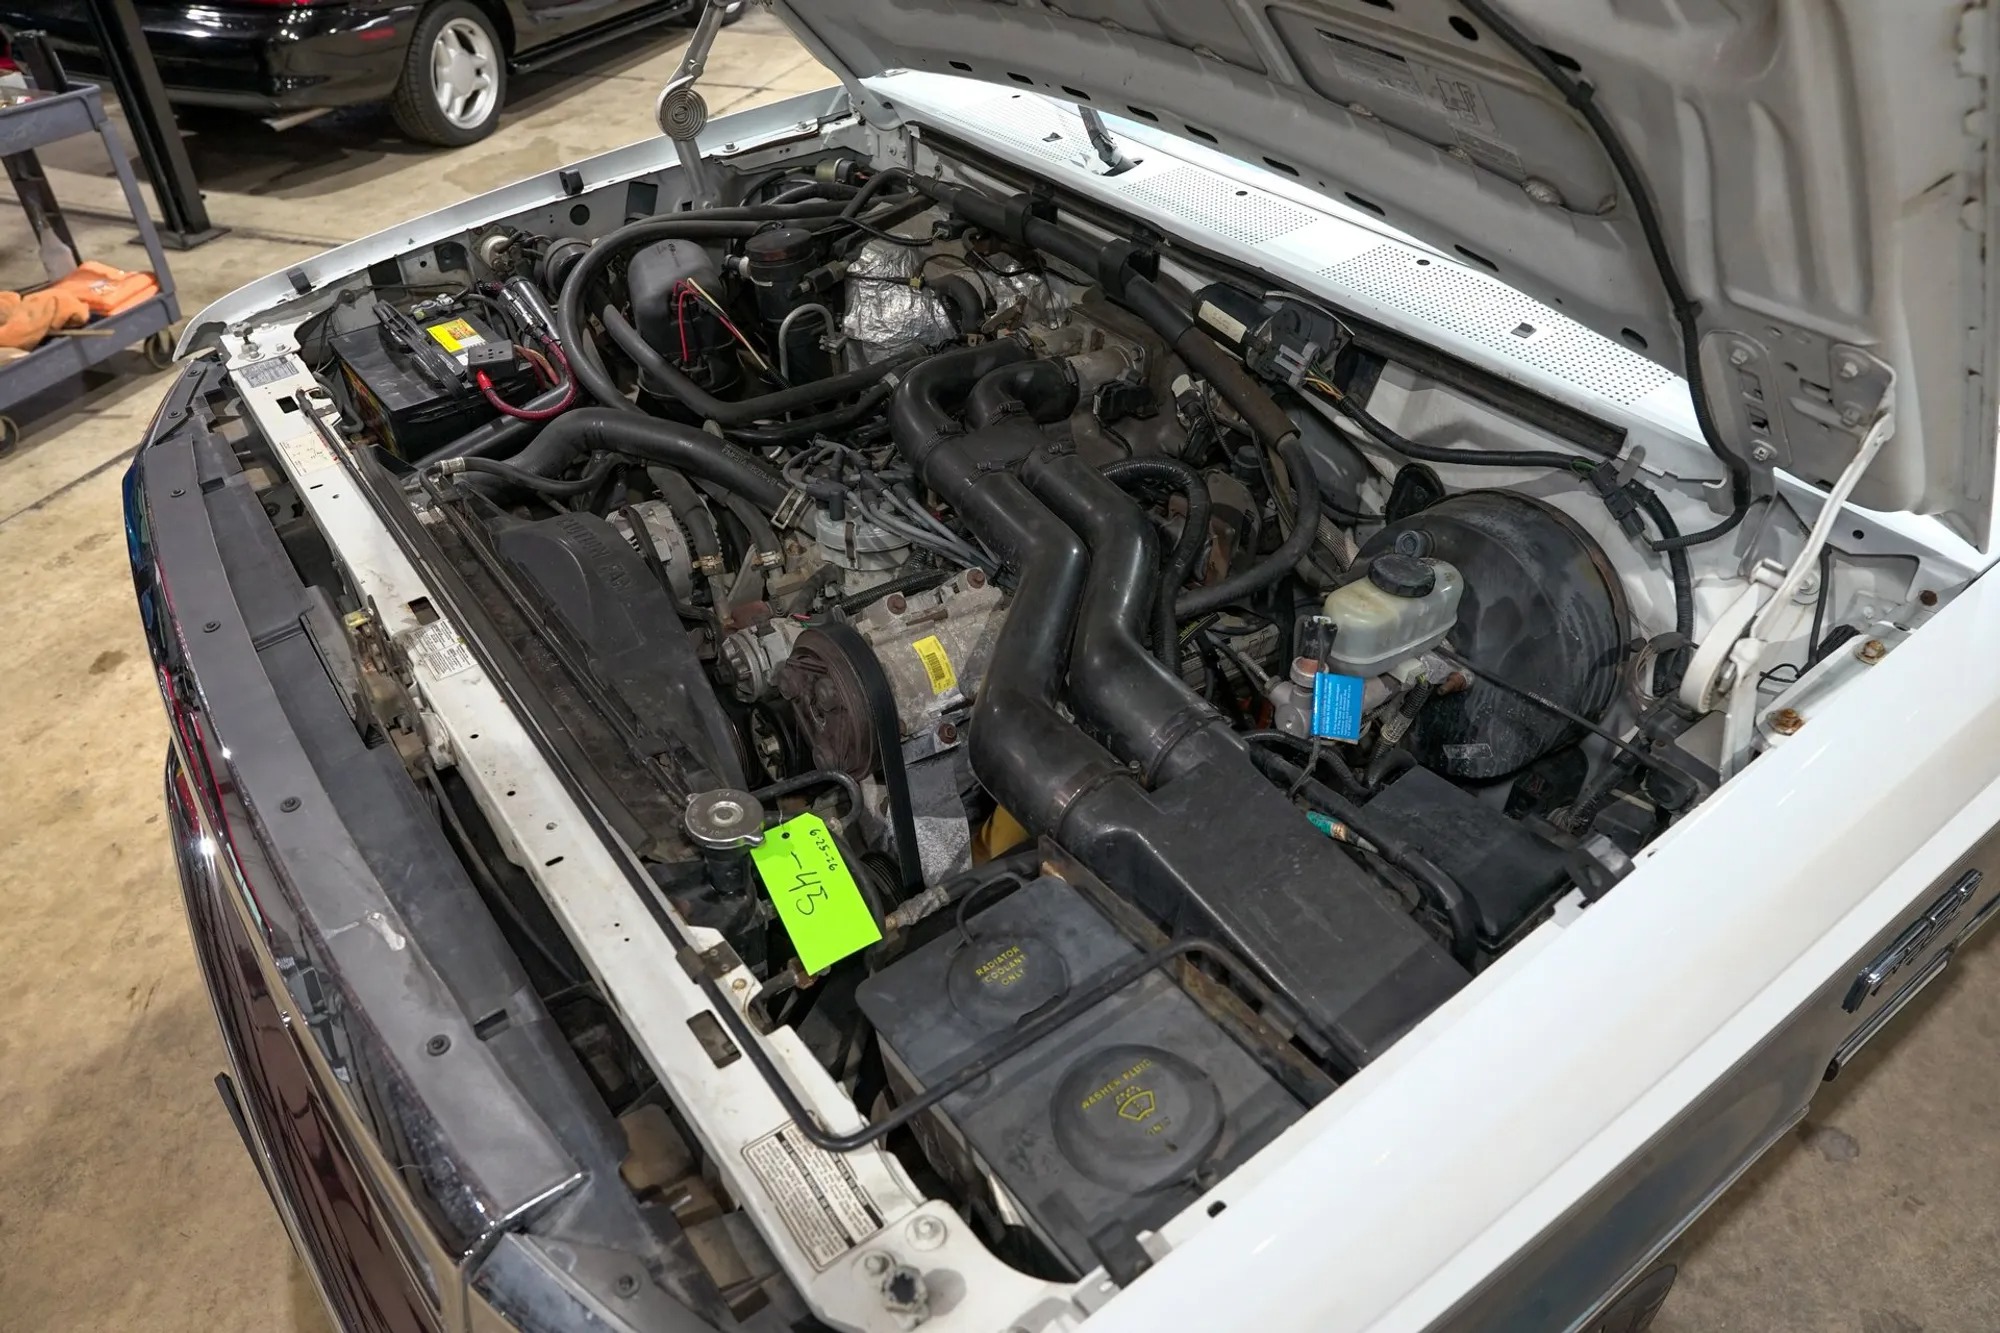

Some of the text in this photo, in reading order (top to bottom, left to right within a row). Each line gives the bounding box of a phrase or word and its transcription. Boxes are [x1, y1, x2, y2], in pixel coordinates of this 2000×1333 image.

[975, 945, 1021, 976] RADIATOR
[984, 954, 1028, 983] COOLANT
[1001, 968, 1025, 987] ONLY
[1081, 1058, 1153, 1110] WASHER FLUID
